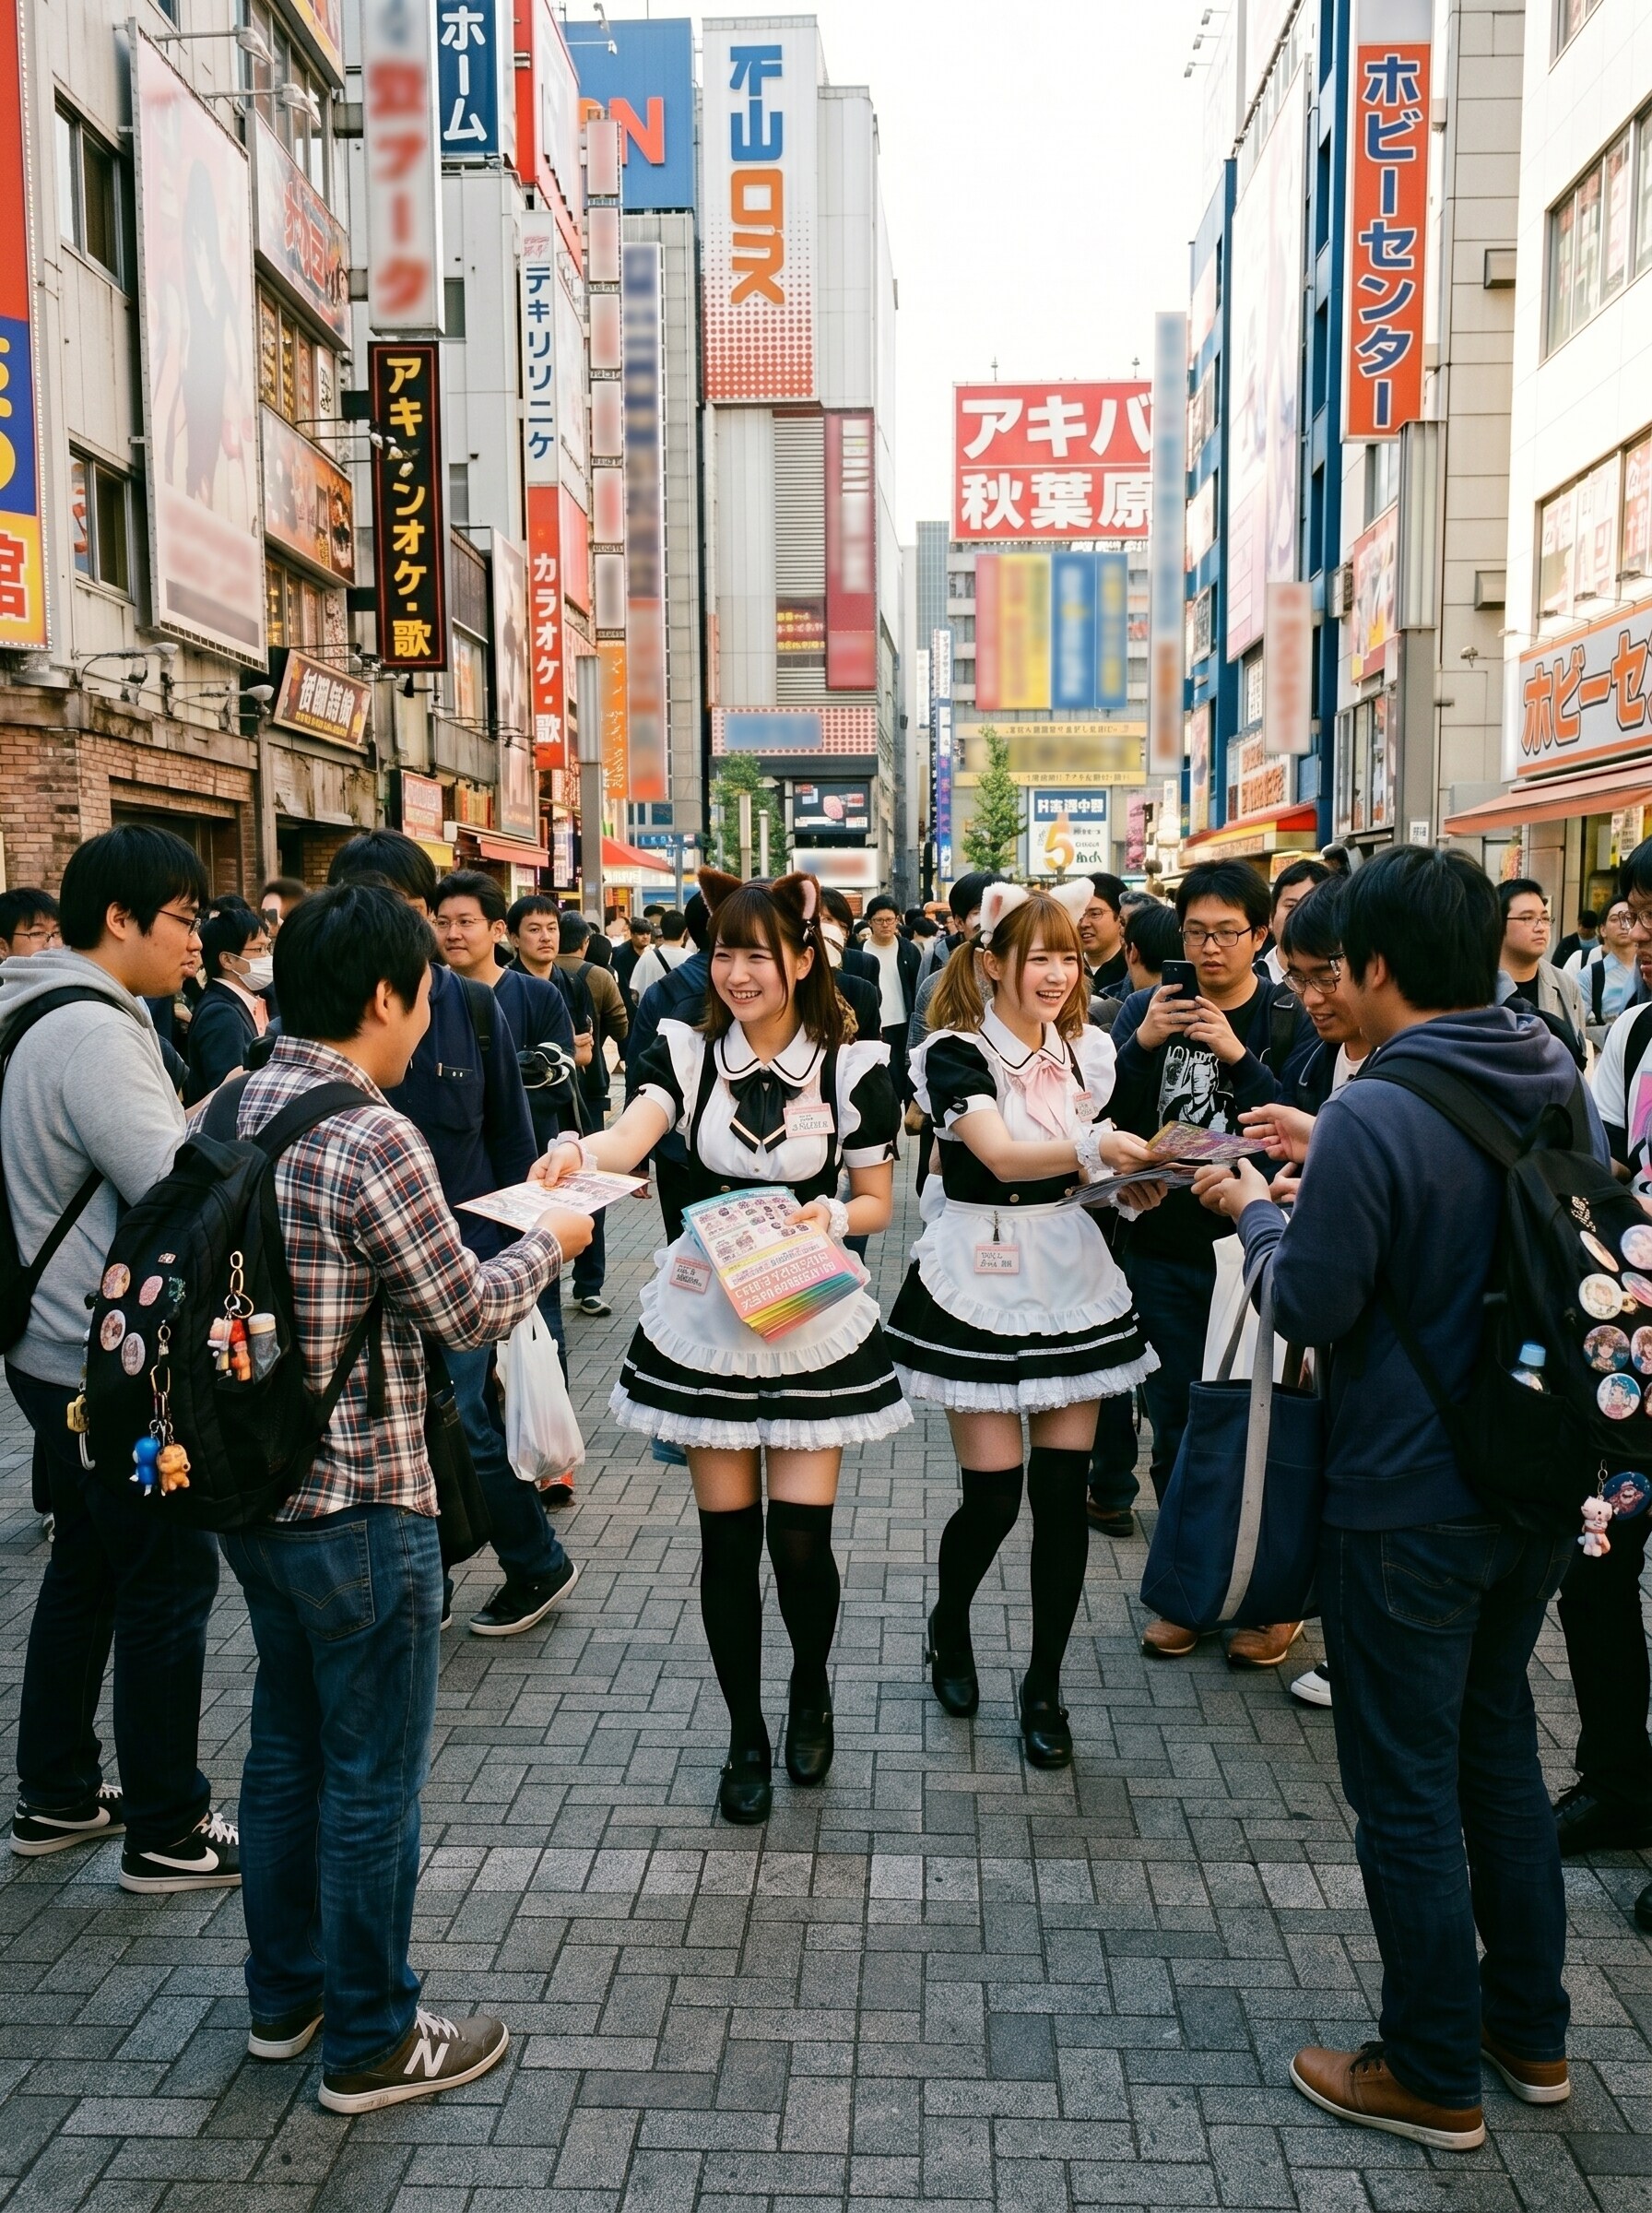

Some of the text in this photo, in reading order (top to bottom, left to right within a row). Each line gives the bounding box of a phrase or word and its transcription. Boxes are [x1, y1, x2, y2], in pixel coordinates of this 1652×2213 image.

[441, 5, 488, 142] ホーム
[1355, 53, 1422, 432] ホビーセンター
[962, 394, 1153, 459] アキバ
[962, 471, 1153, 531] 秋葉原
[533, 552, 561, 744] カラオケ・歌
[1521, 629, 1652, 757] ホビーセ
[403, 2038, 450, 2077] N
